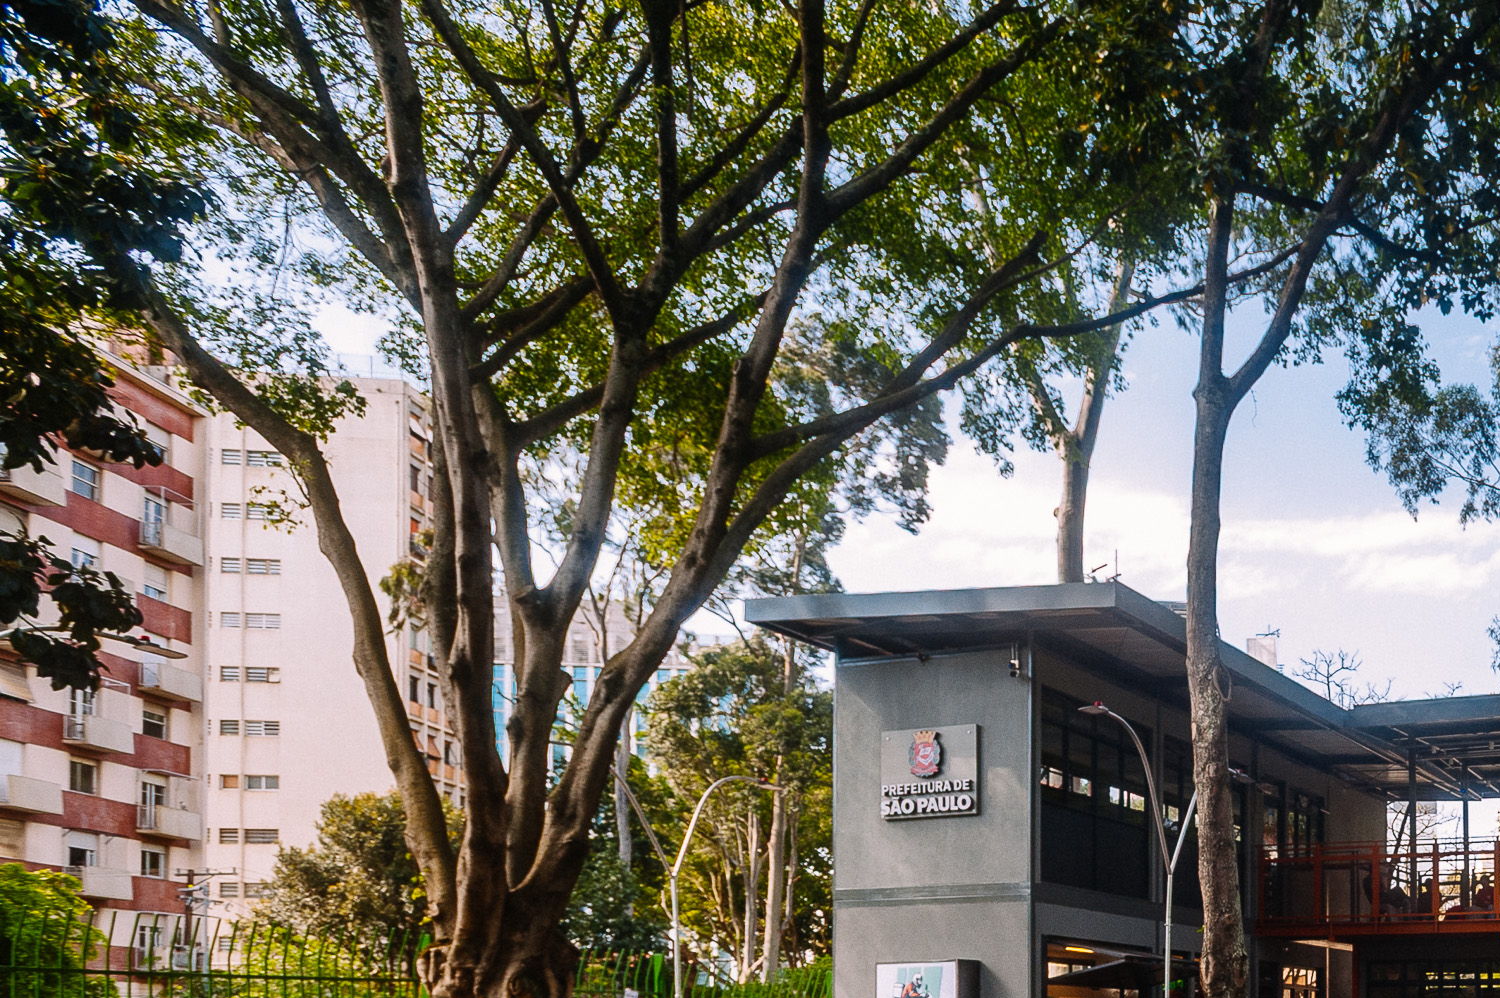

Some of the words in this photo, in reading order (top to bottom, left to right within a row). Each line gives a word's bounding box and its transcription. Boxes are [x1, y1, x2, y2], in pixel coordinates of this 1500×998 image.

[881, 781, 952, 797] PREFEITURA
[953, 779, 970, 791] DE
[881, 796, 914, 816] SÃO
[917, 794, 972, 813] PAULO
